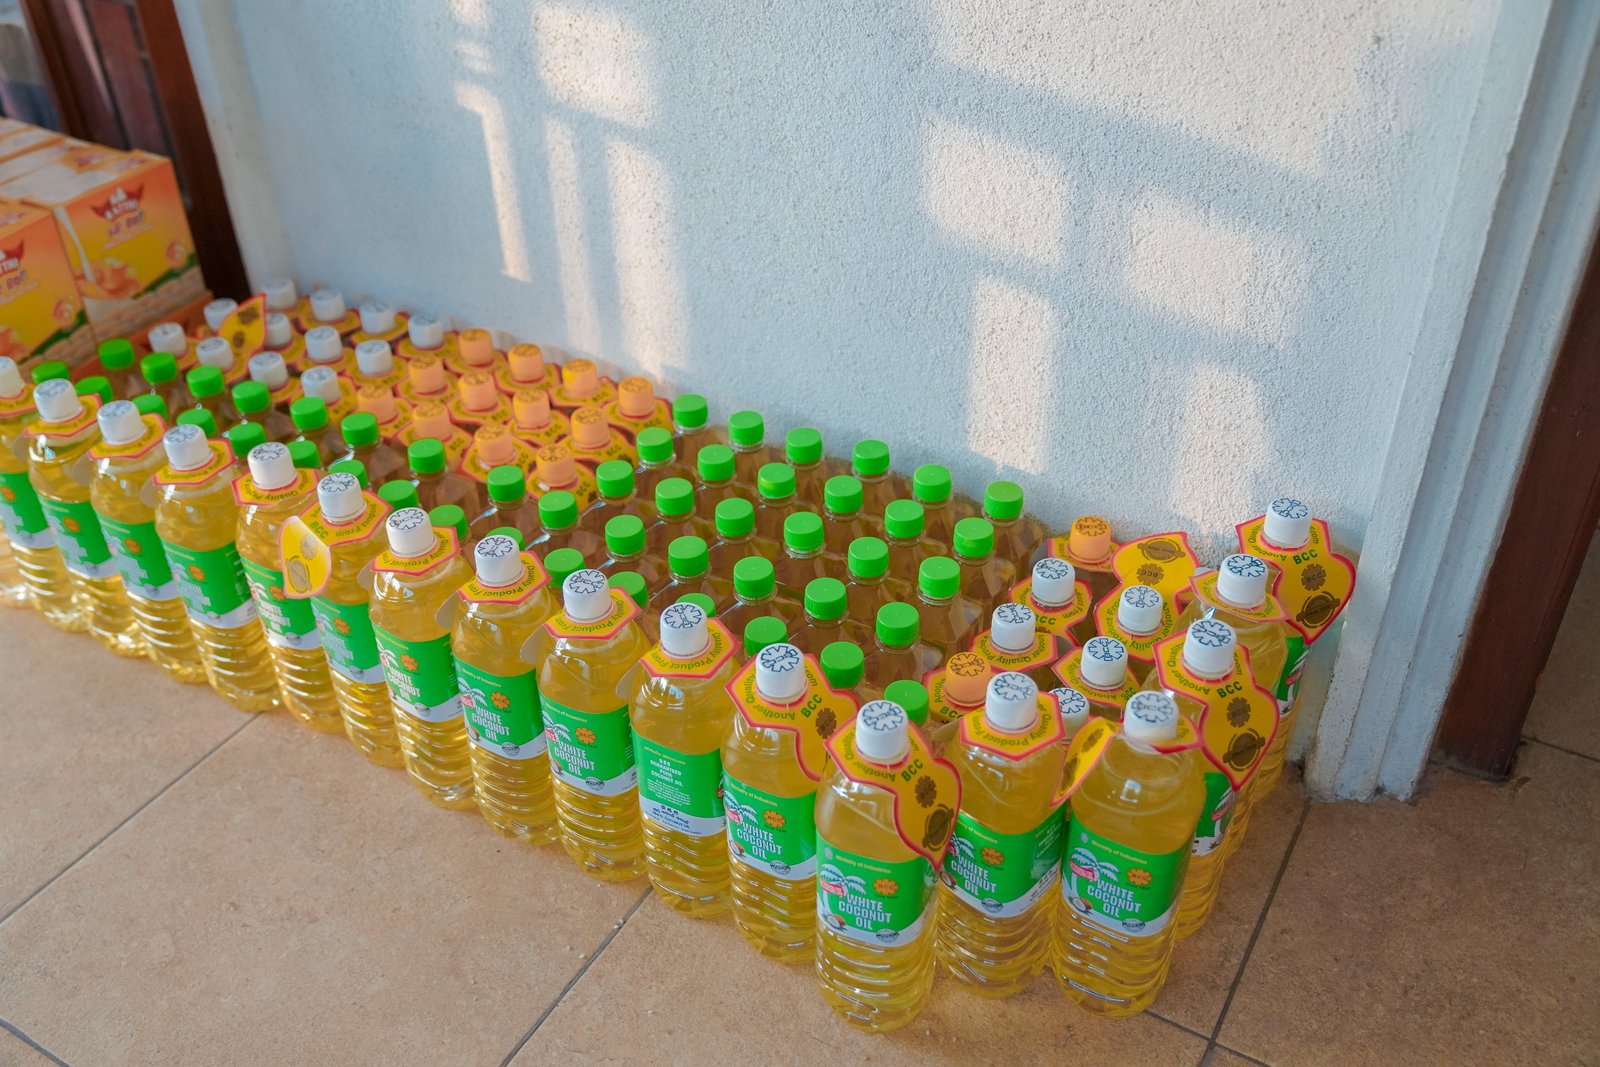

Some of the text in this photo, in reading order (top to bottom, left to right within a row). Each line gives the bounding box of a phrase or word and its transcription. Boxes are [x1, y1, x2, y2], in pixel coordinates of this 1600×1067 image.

[576, 481, 591, 496] BCC
[310, 521, 328, 538] BCC
[430, 540, 449, 560] Quality
[1254, 546, 1287, 561] Another
[1293, 549, 1318, 565] BCC
[390, 559, 430, 567] Product
[523, 566, 535, 587] Quality
[1306, 572, 1322, 582] BCC
[483, 587, 523, 597] Product
[1063, 607, 1083, 619] From
[1107, 600, 1119, 614] Fro
[573, 622, 613, 632] Product
[711, 632, 723, 657] Quality
[670, 659, 713, 670] Product
[996, 656, 1031, 664] Quality
[1172, 669, 1211, 695] Another
[1217, 681, 1243, 698] BCC
[753, 704, 795, 720] Another
[801, 694, 823, 718] BCC
[476, 707, 501, 724] WHITE
[472, 713, 510, 736] COCONUT
[1030, 714, 1051, 740] Quality
[486, 730, 498, 742] OIL
[984, 731, 1029, 746] Product
[559, 741, 586, 759] WHITE
[554, 747, 595, 771] COCONUT
[569, 763, 582, 776] OIL
[854, 761, 895, 782] Another
[901, 759, 923, 782] BCC
[742, 822, 773, 843] WHITE
[737, 829, 782, 855] COCONUT
[752, 846, 767, 859] OIL
[958, 855, 988, 879] WHITE
[951, 860, 997, 893] COCONUT
[965, 880, 978, 895] OIL
[1097, 879, 1133, 900] WHITE
[847, 894, 883, 912] WHITE
[1087, 886, 1141, 913] COCONUT
[838, 901, 891, 923] COCONUT
[1103, 904, 1120, 917] OIL
[856, 918, 872, 929] OIL
